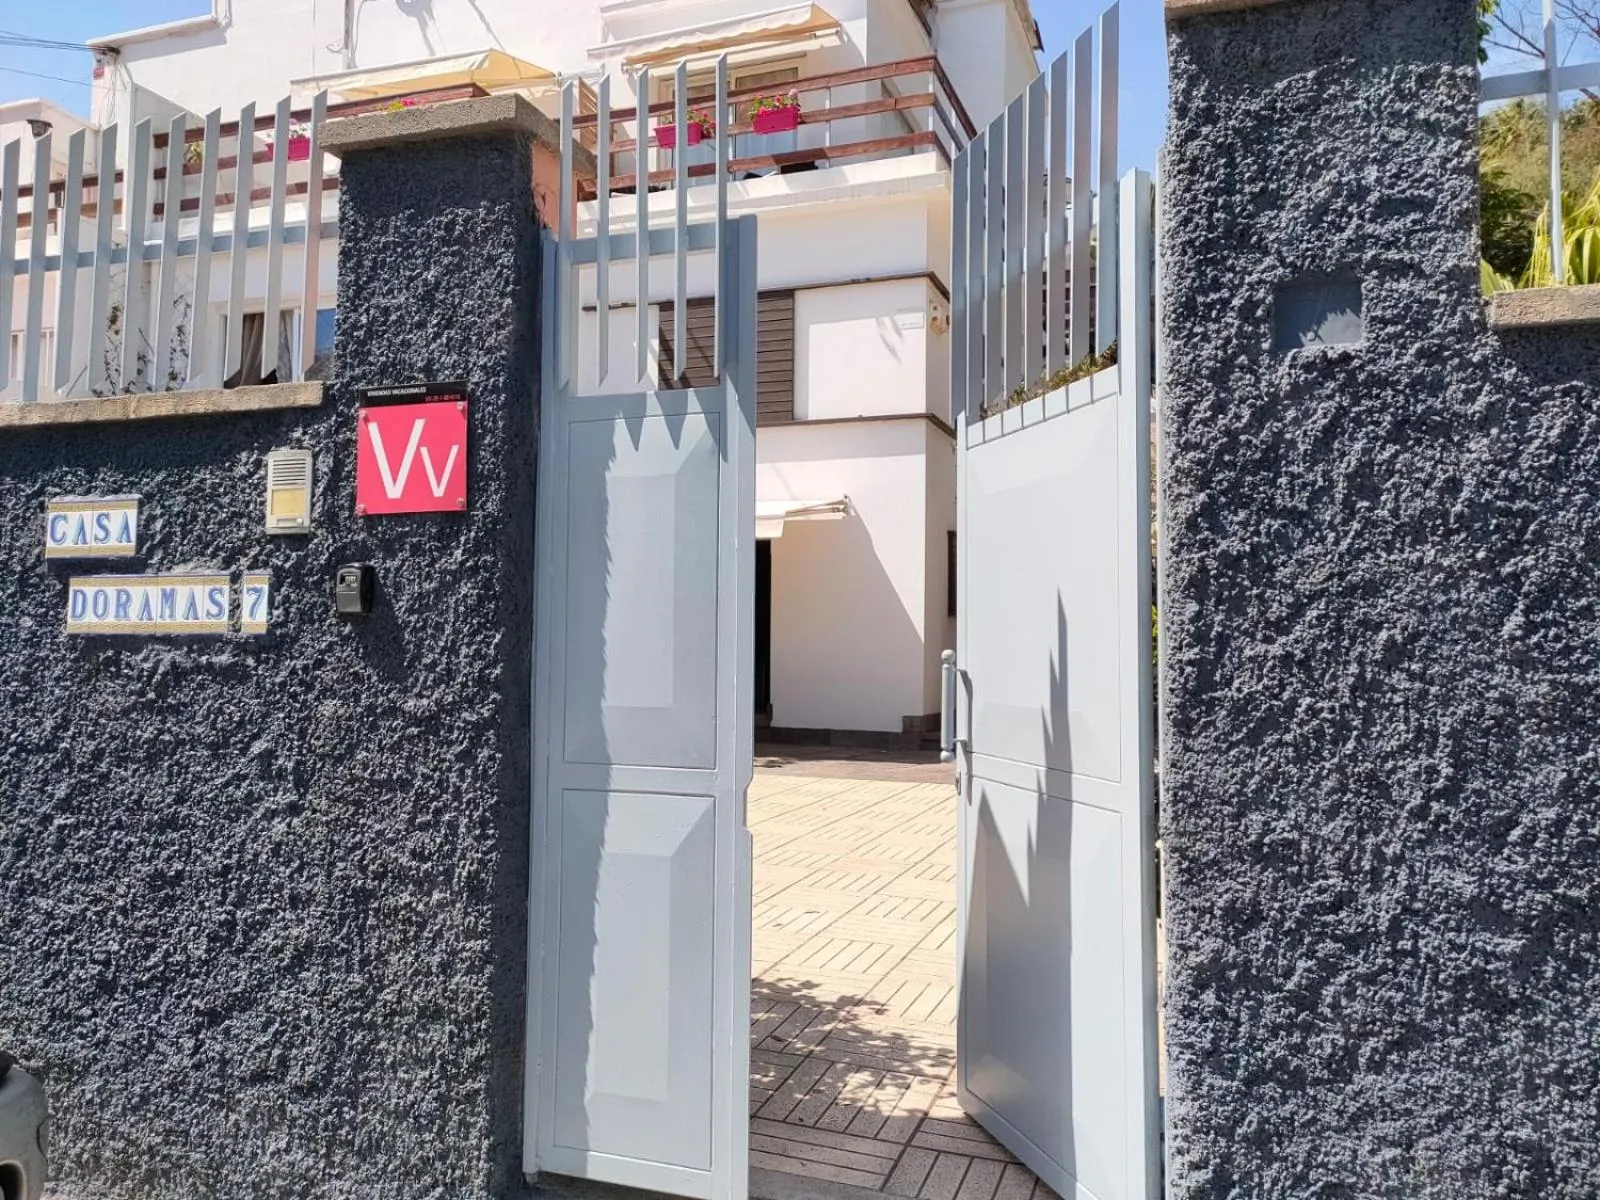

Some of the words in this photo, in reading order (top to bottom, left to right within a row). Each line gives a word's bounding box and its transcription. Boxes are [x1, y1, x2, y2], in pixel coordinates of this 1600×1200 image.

[49, 511, 134, 546] CASA
[71, 586, 226, 622] DORAMAS
[245, 586, 266, 621] 7
